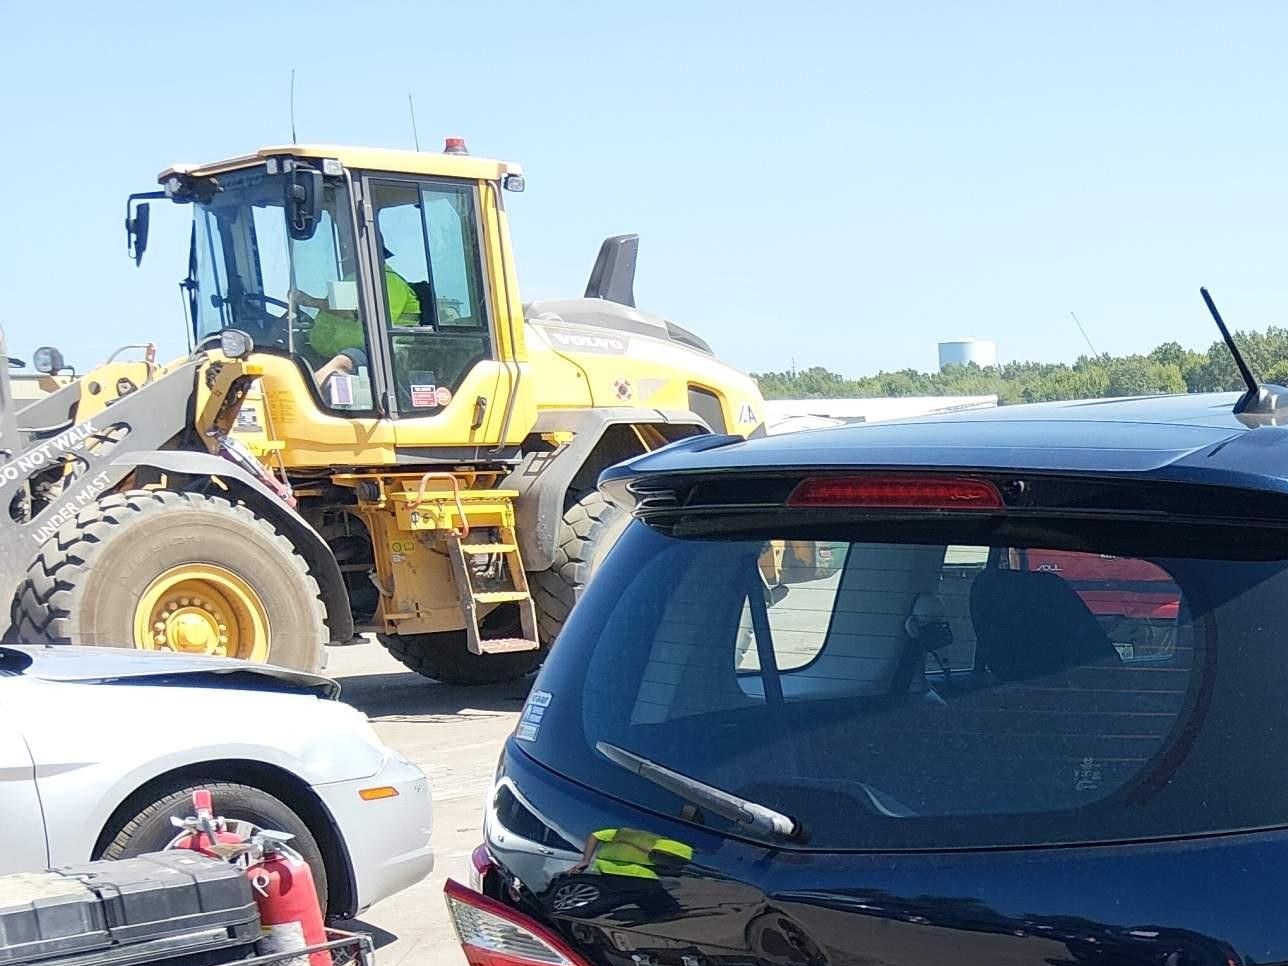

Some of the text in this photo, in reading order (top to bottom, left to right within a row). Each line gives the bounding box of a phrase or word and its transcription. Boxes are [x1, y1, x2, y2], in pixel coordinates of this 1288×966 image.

[18, 446, 54, 473] NOT
[52, 421, 98, 451] WALK
[32, 471, 112, 542] UNDER MAST
